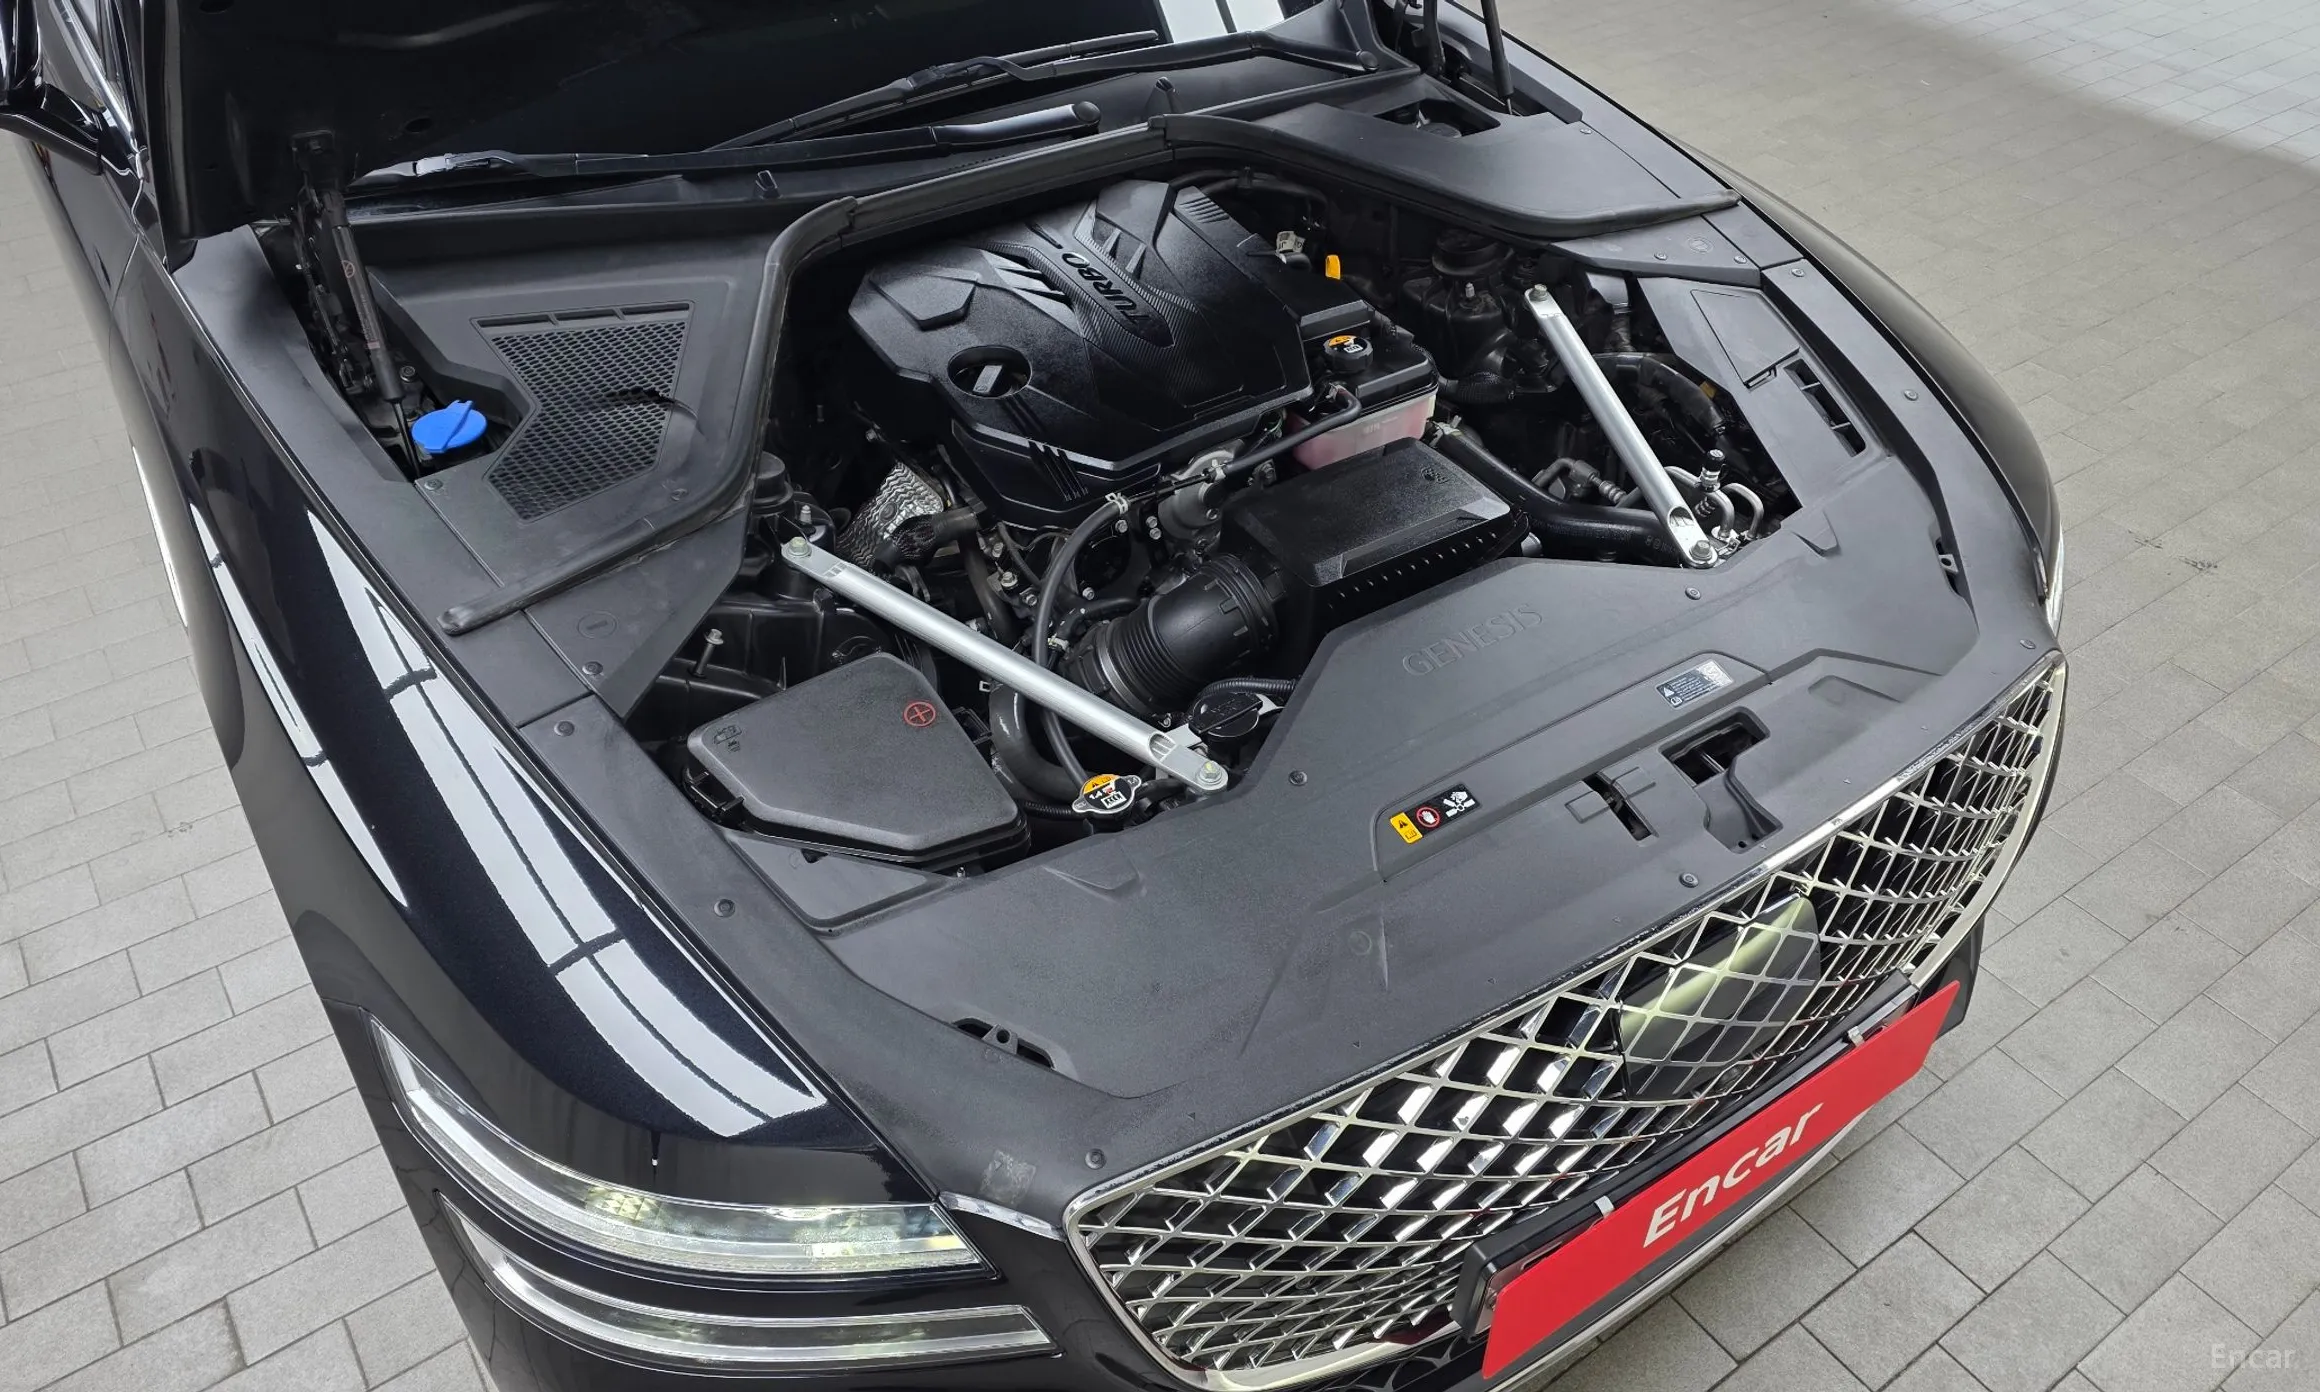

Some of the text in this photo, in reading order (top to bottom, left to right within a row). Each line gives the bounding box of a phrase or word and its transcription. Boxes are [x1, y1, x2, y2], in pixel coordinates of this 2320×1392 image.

[1062, 252, 1150, 325] TURBO
[1402, 603, 1543, 676] GENESIS
[1643, 1102, 1824, 1249] Encar
